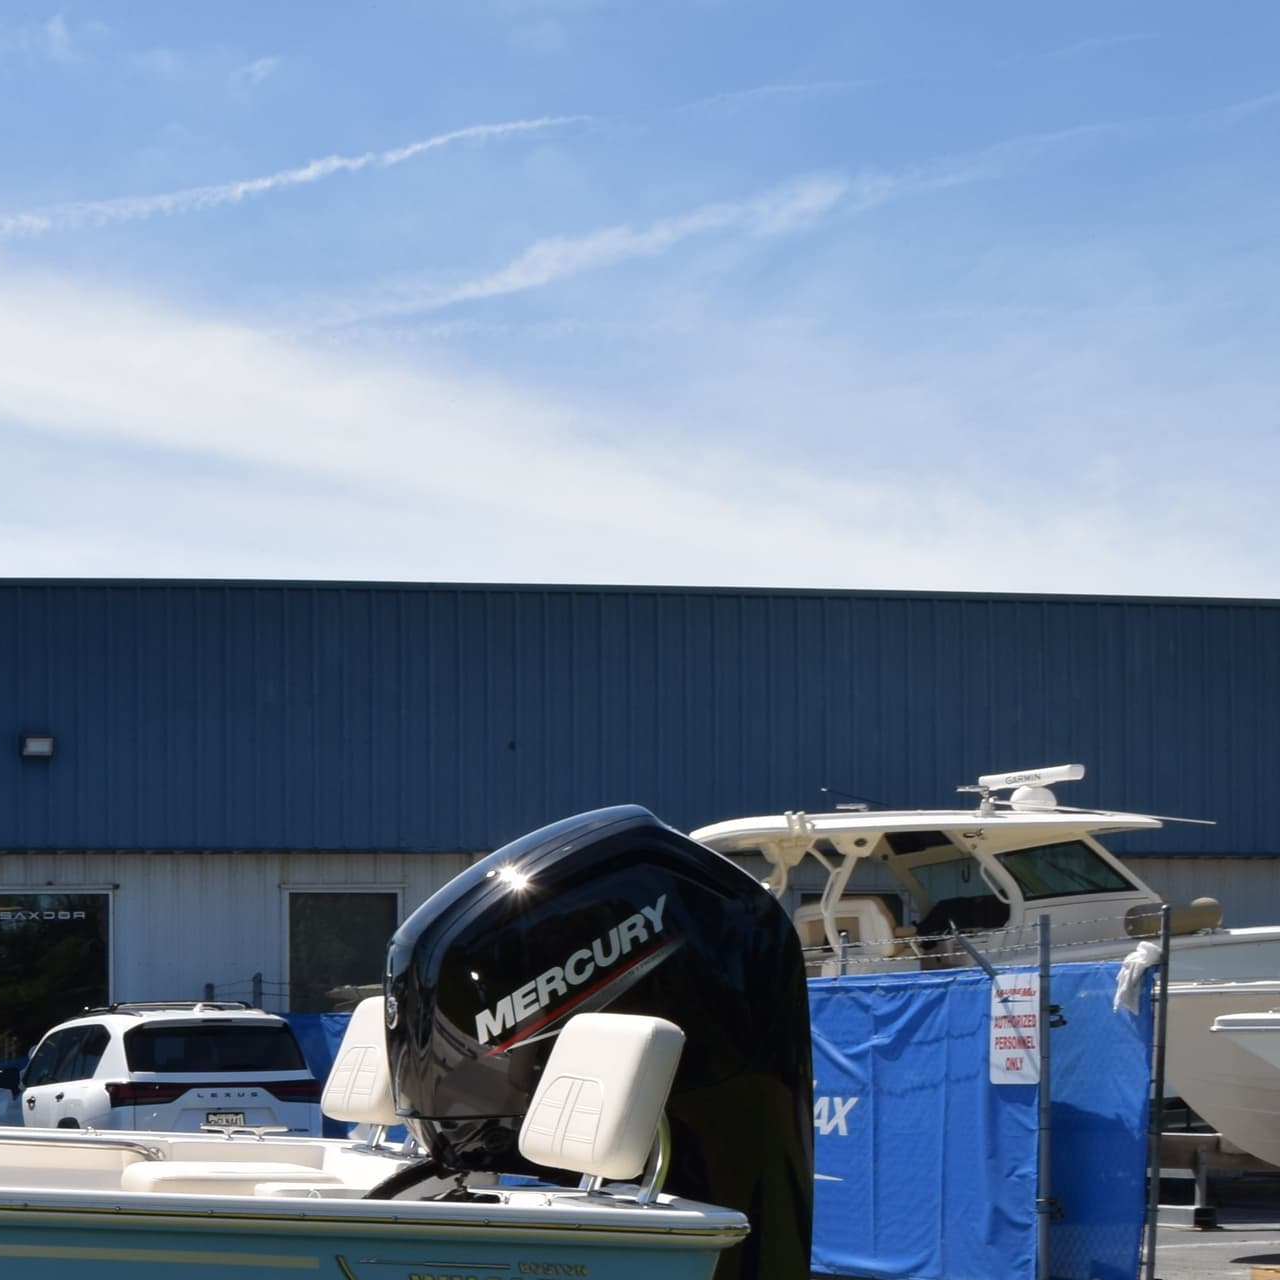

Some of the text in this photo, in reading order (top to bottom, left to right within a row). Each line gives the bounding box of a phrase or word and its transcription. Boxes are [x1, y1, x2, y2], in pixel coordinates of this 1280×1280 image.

[1005, 773, 1041, 785] GARMIN
[0, 911, 87, 920] SAXDOR
[475, 894, 667, 1046] MERCURY
[994, 1014, 1037, 1029] AUTHORIZED
[995, 1036, 1036, 1050] PERSONNEL
[1006, 1057, 1024, 1071] ONLY
